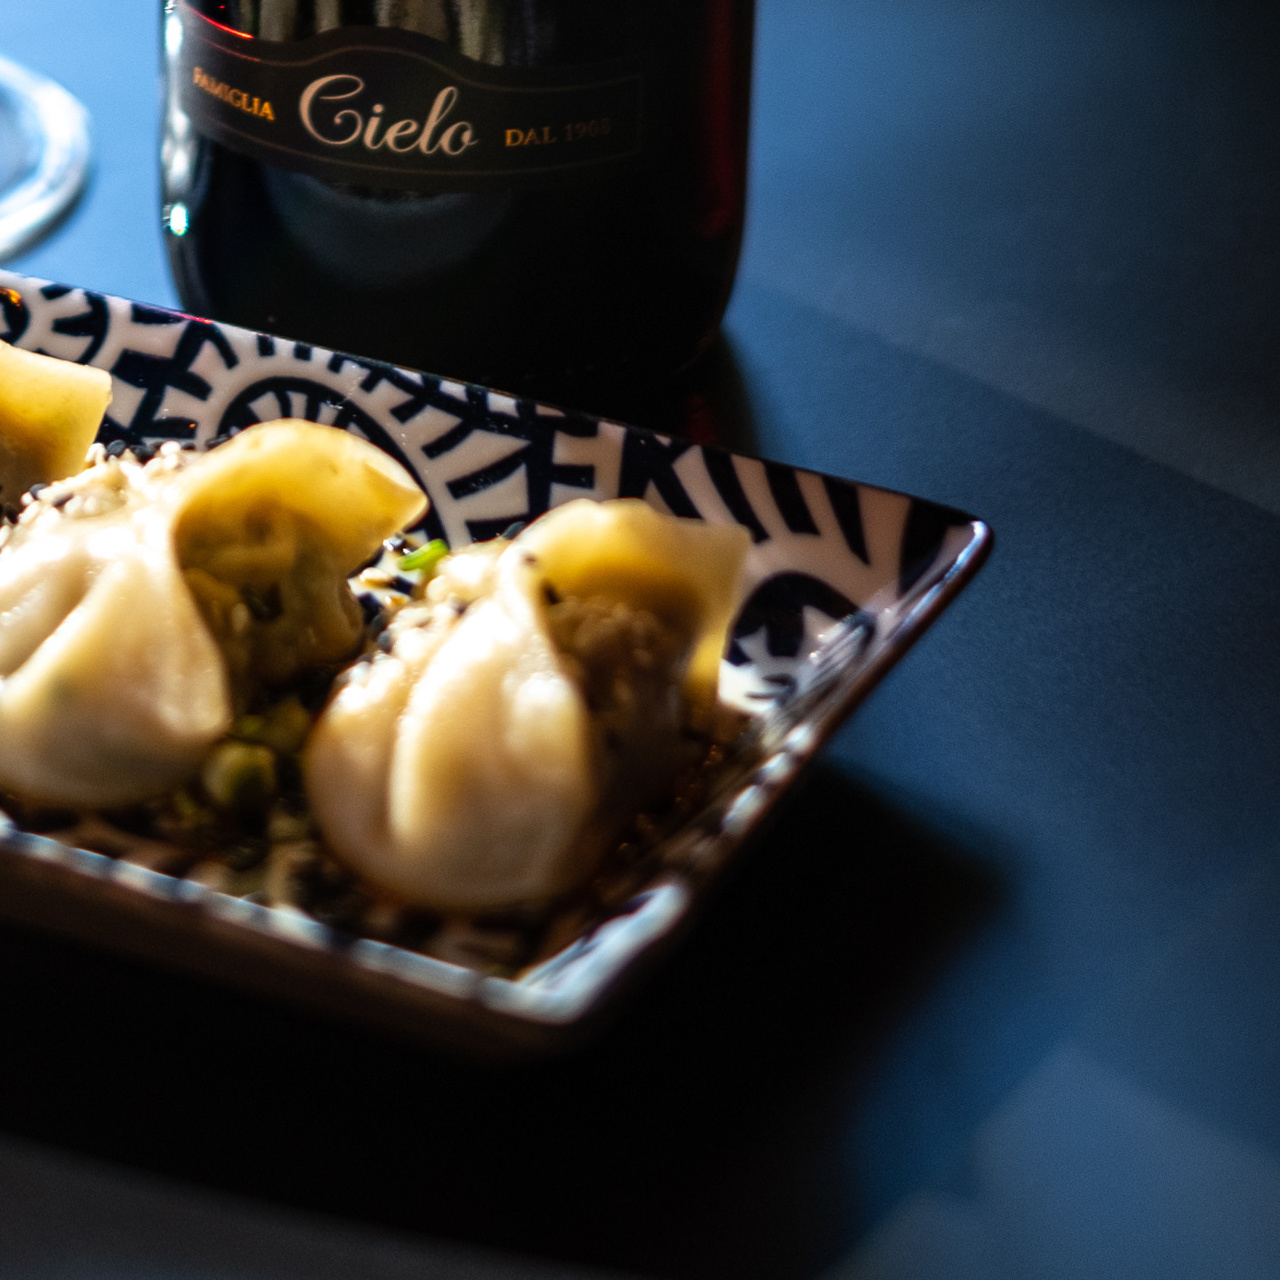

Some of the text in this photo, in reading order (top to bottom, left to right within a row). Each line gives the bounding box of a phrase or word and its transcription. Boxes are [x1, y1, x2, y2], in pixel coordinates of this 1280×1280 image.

[193, 66, 275, 121] FAMIGLIA
[298, 73, 479, 157] Cielo
[505, 125, 558, 148] DAL
